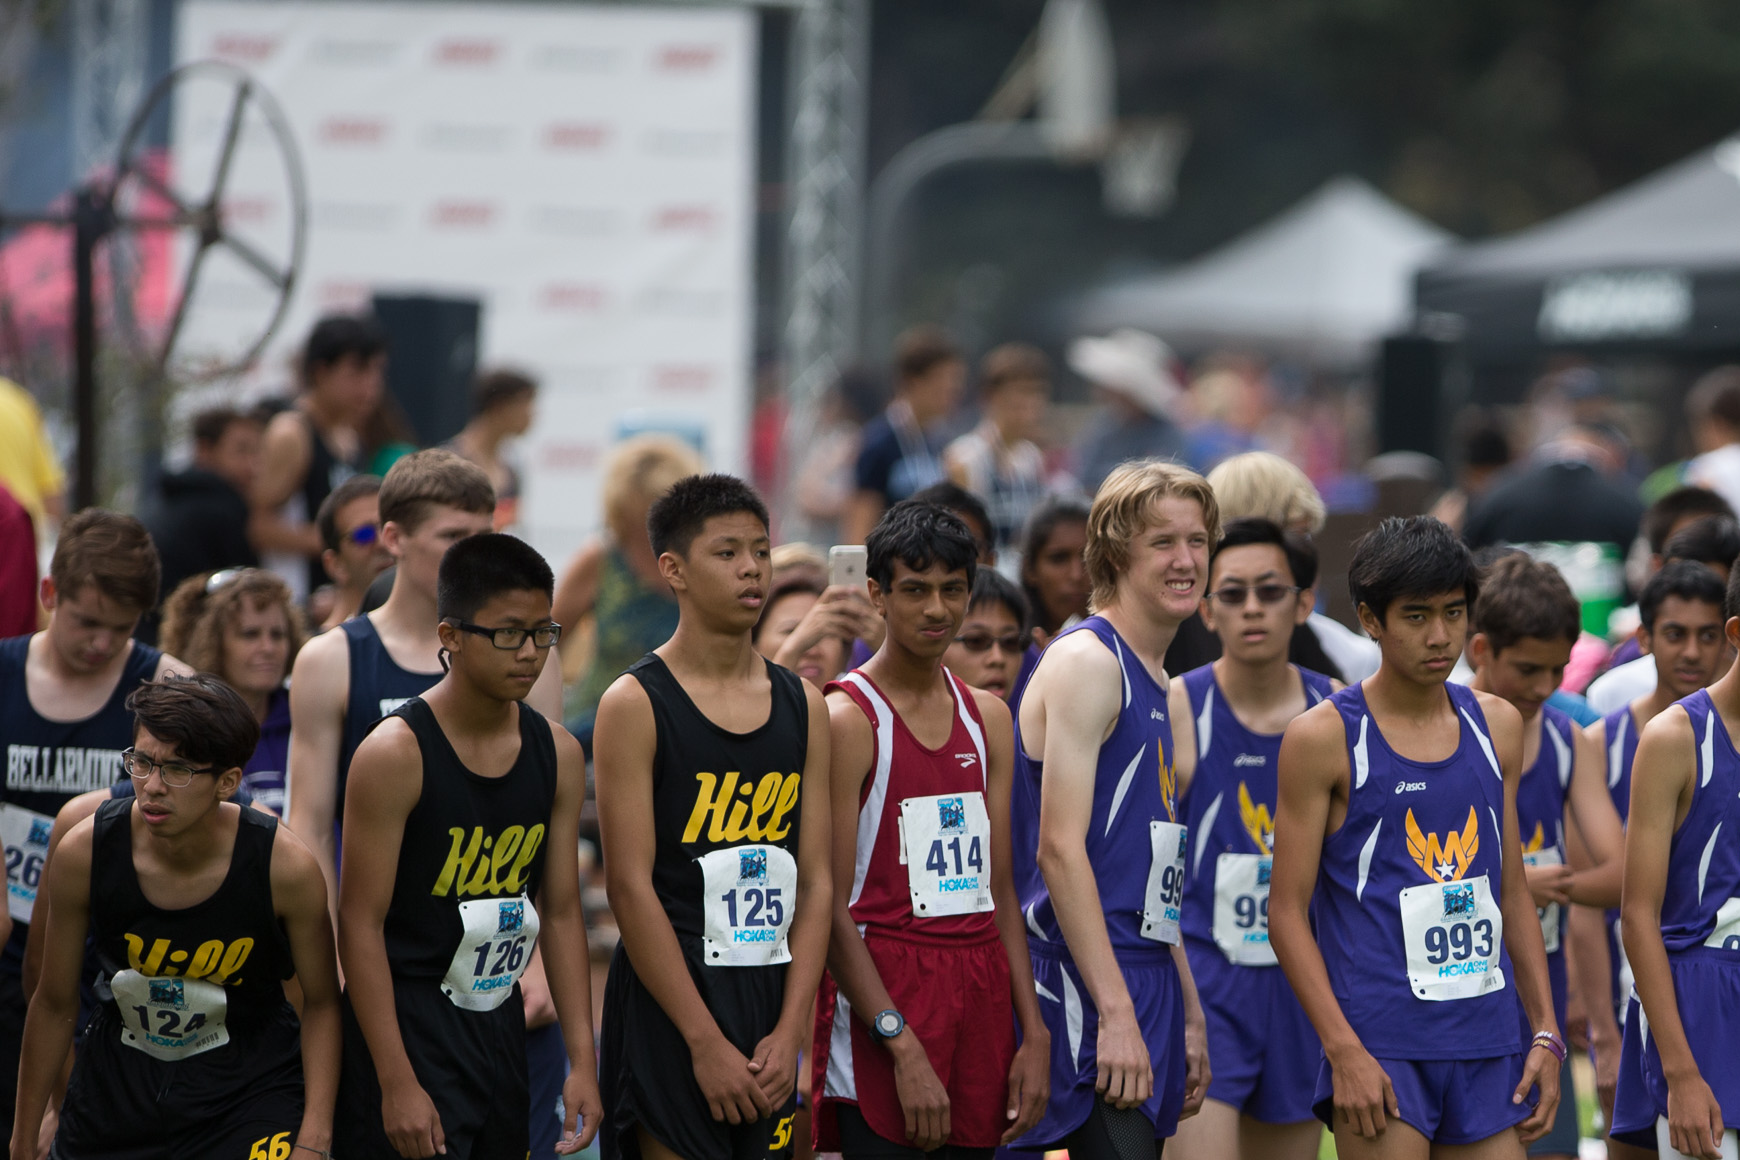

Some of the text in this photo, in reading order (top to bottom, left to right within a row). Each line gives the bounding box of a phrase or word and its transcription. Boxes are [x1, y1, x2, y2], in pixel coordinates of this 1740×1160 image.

[1405, 782, 1426, 792] asics
[681, 772, 800, 843] Hill
[431, 823, 545, 897] Hill
[926, 836, 983, 877] 414
[939, 878, 968, 892] HOKA
[722, 888, 783, 927] 125
[734, 930, 766, 943] HOKA
[1424, 918, 1493, 965] 993
[473, 935, 527, 977] 126
[1438, 961, 1475, 978] HOKA
[472, 976, 503, 991] HOKA
[132, 1005, 206, 1038] 124
[146, 1032, 185, 1048] HOKA
